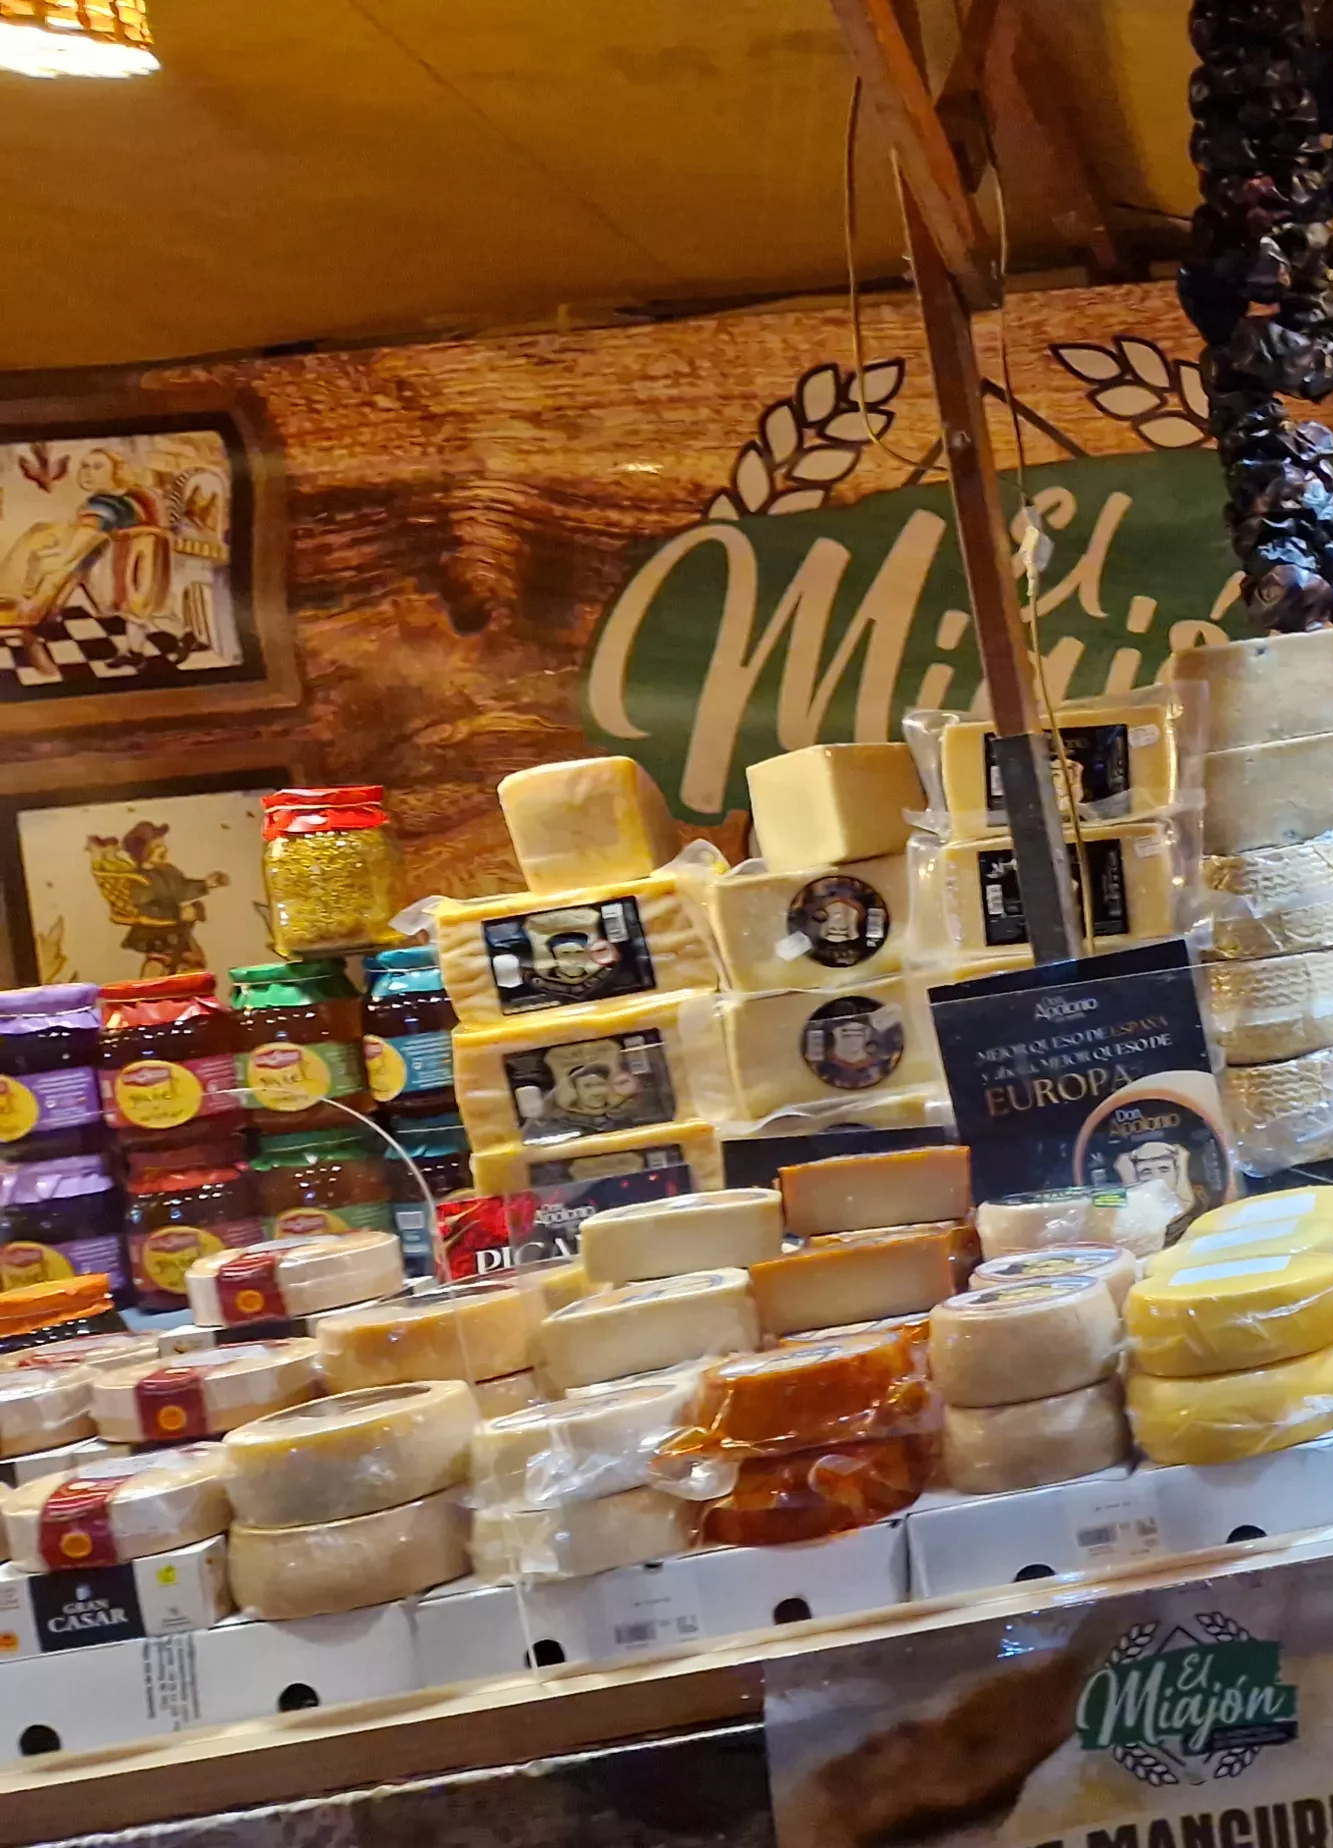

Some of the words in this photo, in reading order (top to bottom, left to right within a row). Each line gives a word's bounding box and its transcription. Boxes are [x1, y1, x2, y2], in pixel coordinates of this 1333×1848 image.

[1092, 1039, 1148, 1061] QUESO
[1150, 1033, 1173, 1048] DE
[984, 1063, 1134, 1117] EUROPA
[1115, 1109, 1141, 1122] Don
[476, 1233, 582, 1275] PICA
[47, 1608, 129, 1633] CASAR
[1177, 1653, 1215, 1691] El
[1077, 1661, 1285, 1750] Miajón
